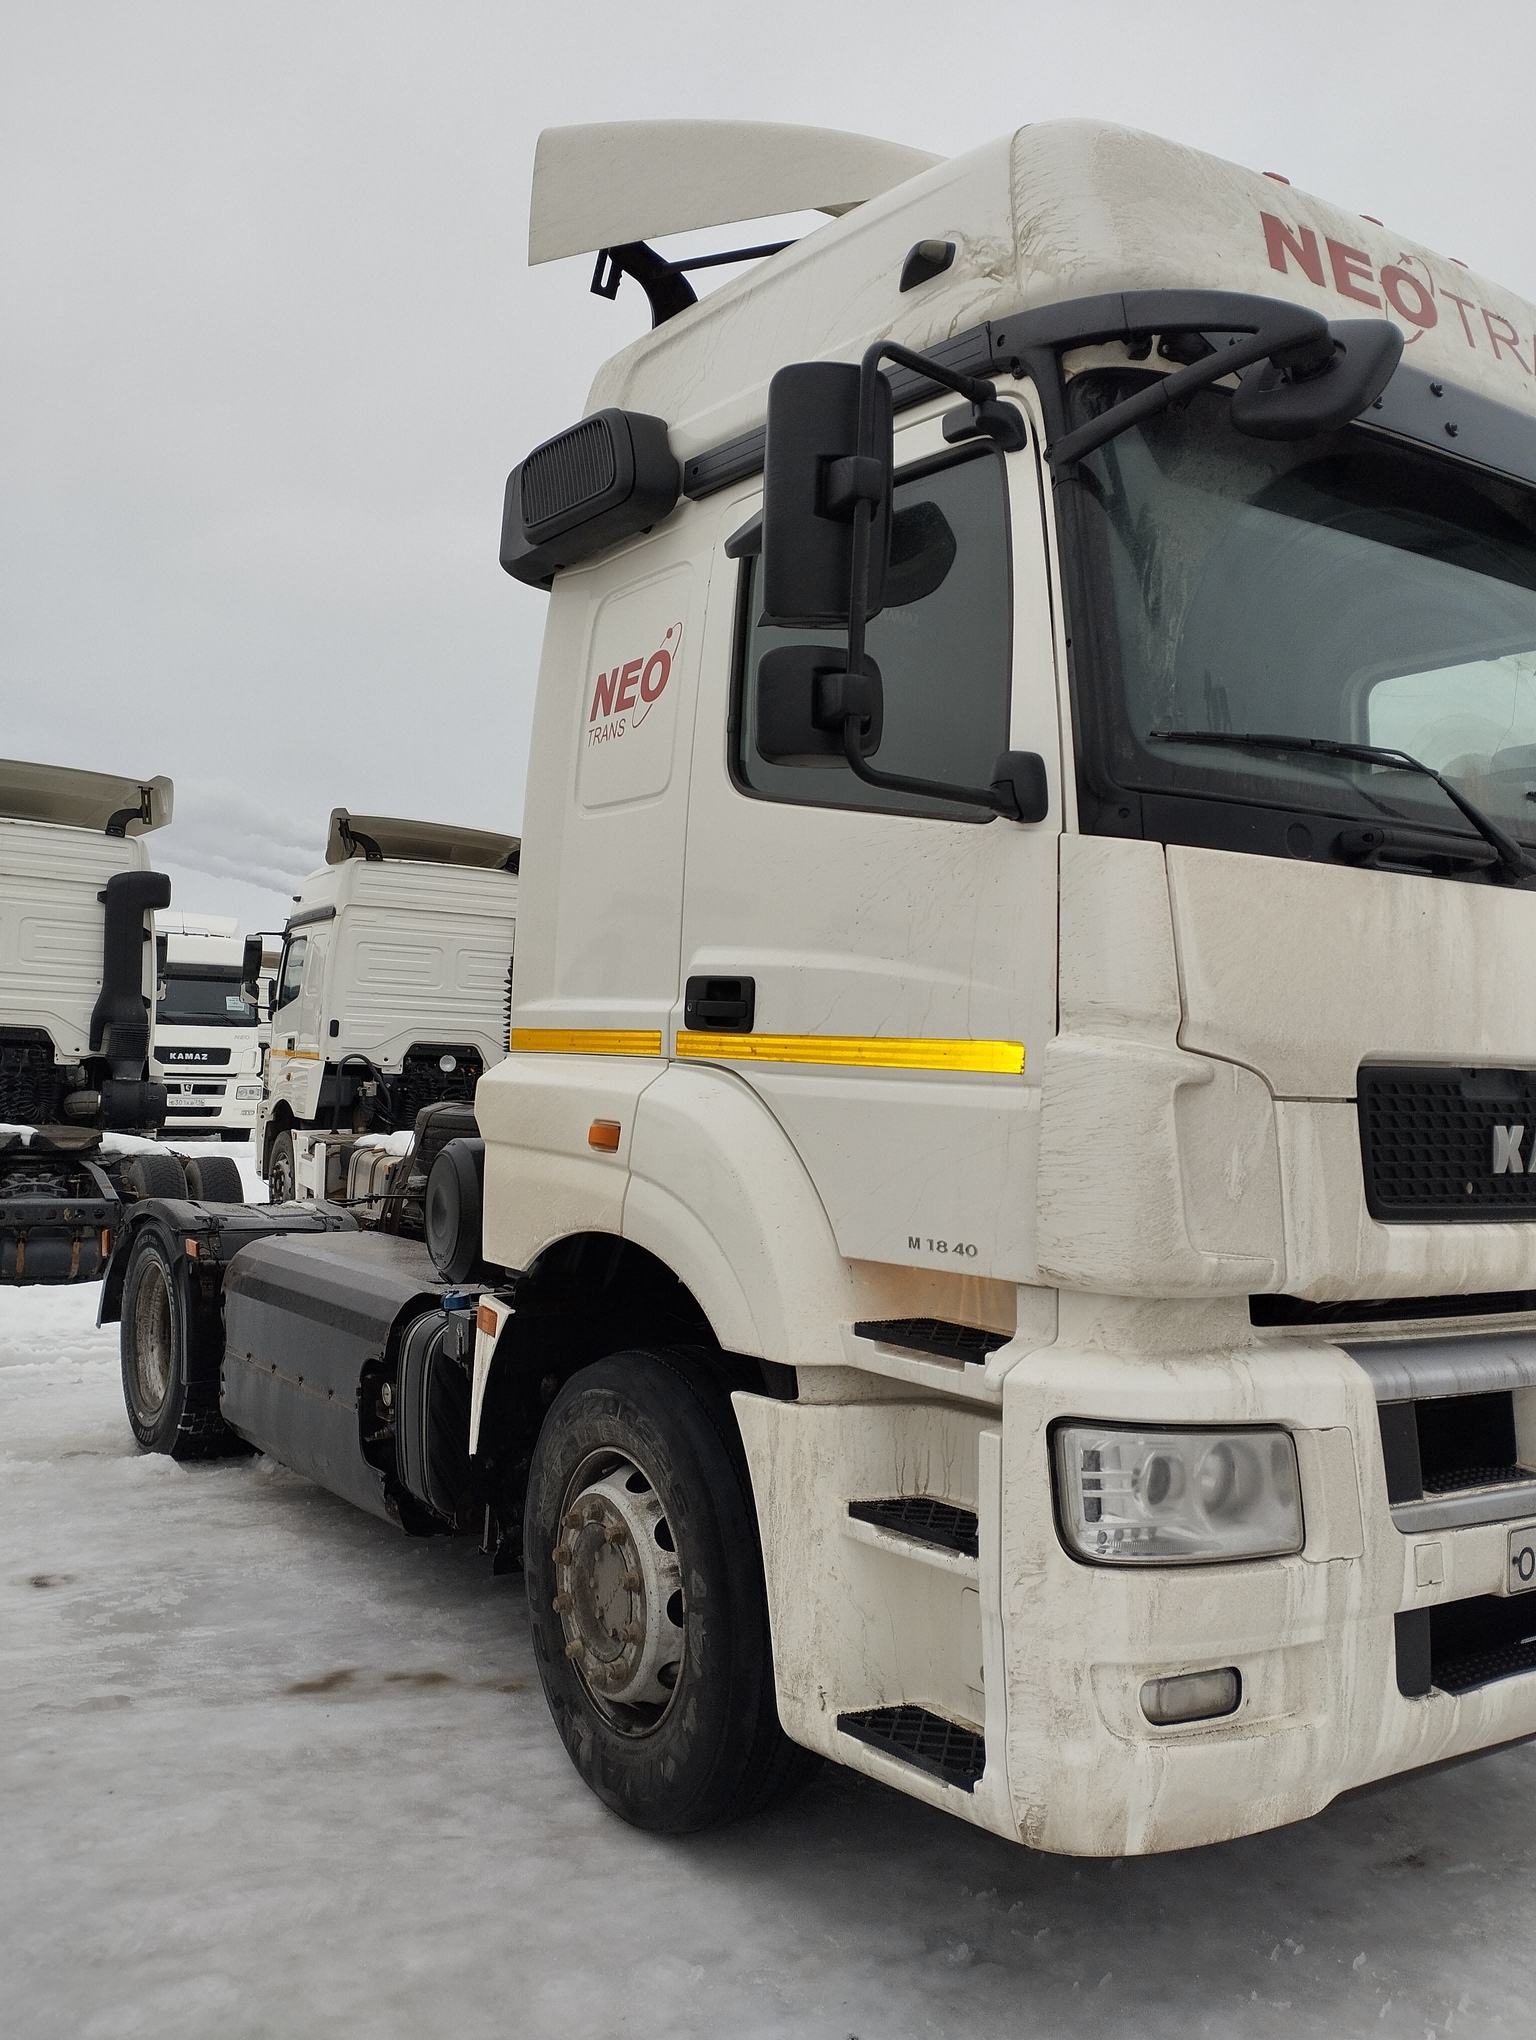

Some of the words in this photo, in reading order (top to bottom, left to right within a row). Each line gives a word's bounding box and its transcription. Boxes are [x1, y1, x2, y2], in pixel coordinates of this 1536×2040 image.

[1260, 211, 1438, 329] NEO
[1439, 288, 1536, 376] TR
[589, 648, 672, 723] NEO
[588, 718, 626, 747] TRANS
[169, 1052, 208, 1060] KAMAZ
[1492, 1125, 1536, 1174] K
[908, 1235, 921, 1250] M
